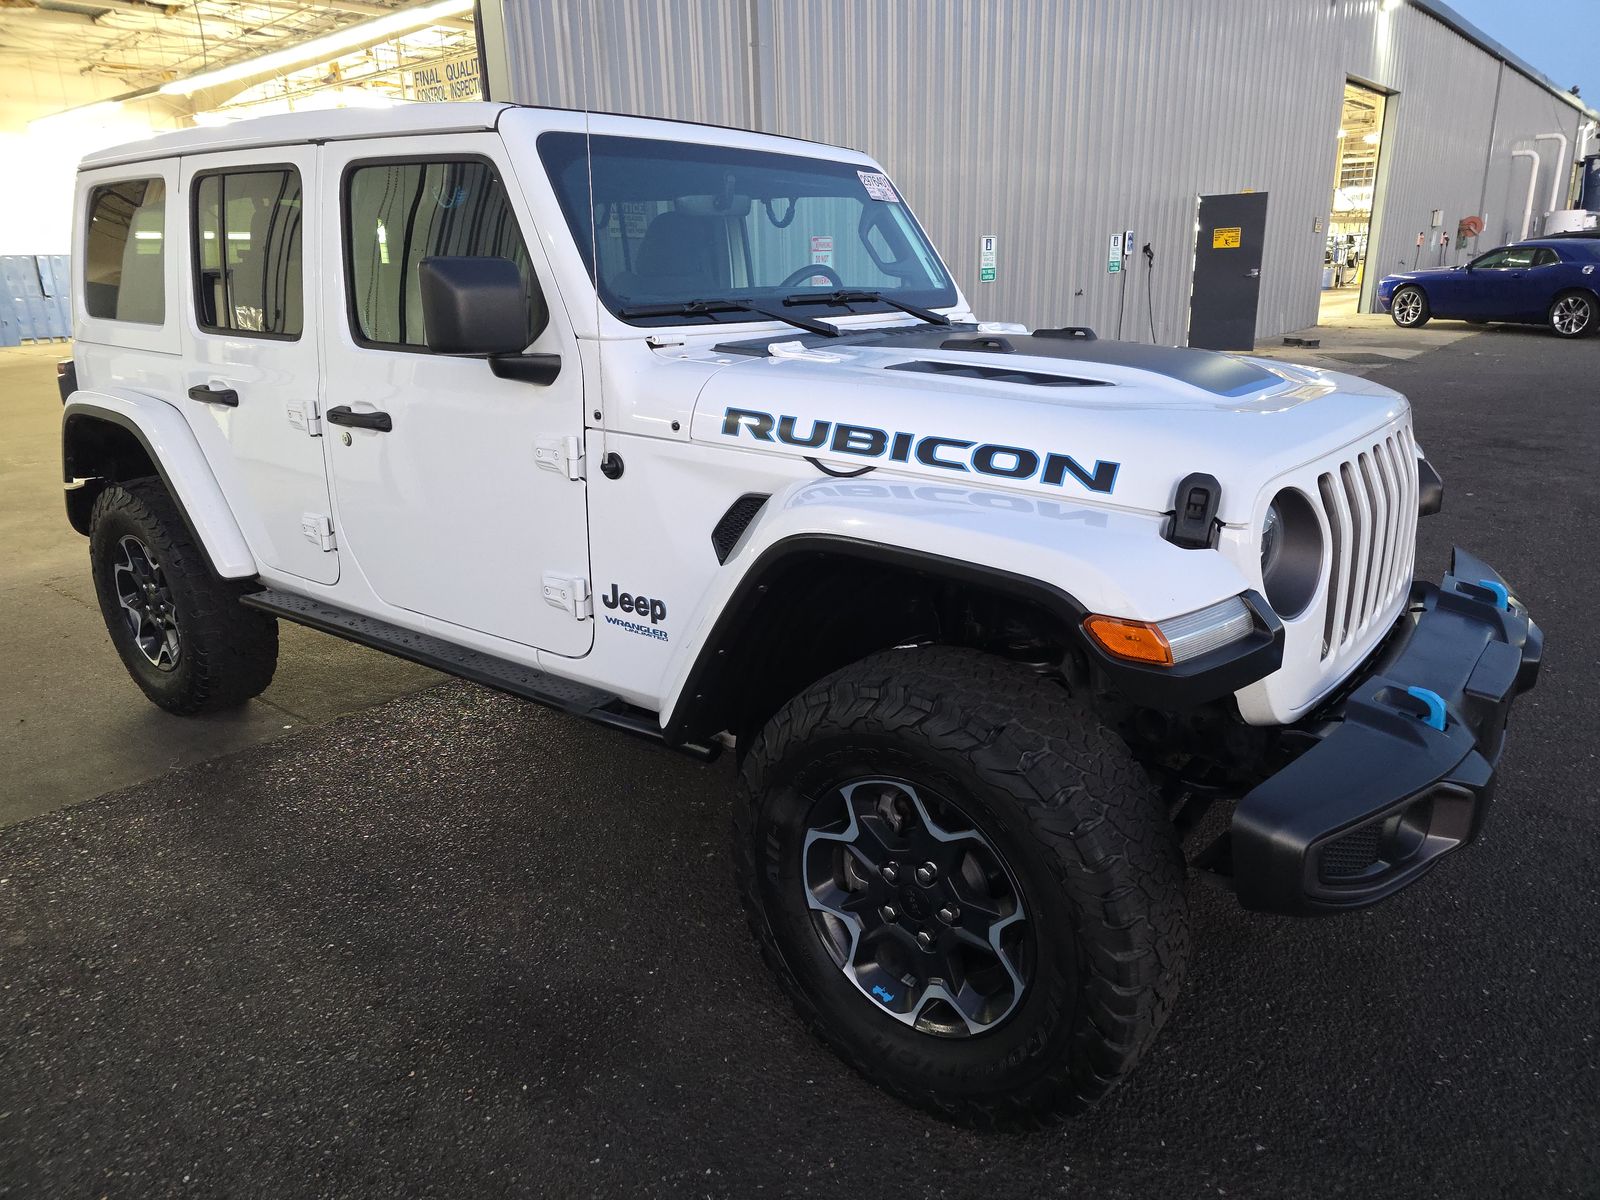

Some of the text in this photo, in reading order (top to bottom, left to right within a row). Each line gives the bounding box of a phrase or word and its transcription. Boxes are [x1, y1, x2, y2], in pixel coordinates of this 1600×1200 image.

[414, 58, 479, 87] FINAL QUALIT
[416, 77, 480, 102] CONTROL INSPECTI
[610, 202, 645, 213] NTICE
[721, 407, 1121, 495] RUBICON
[602, 583, 667, 625] Jeep
[605, 615, 668, 639] WRANGLER
